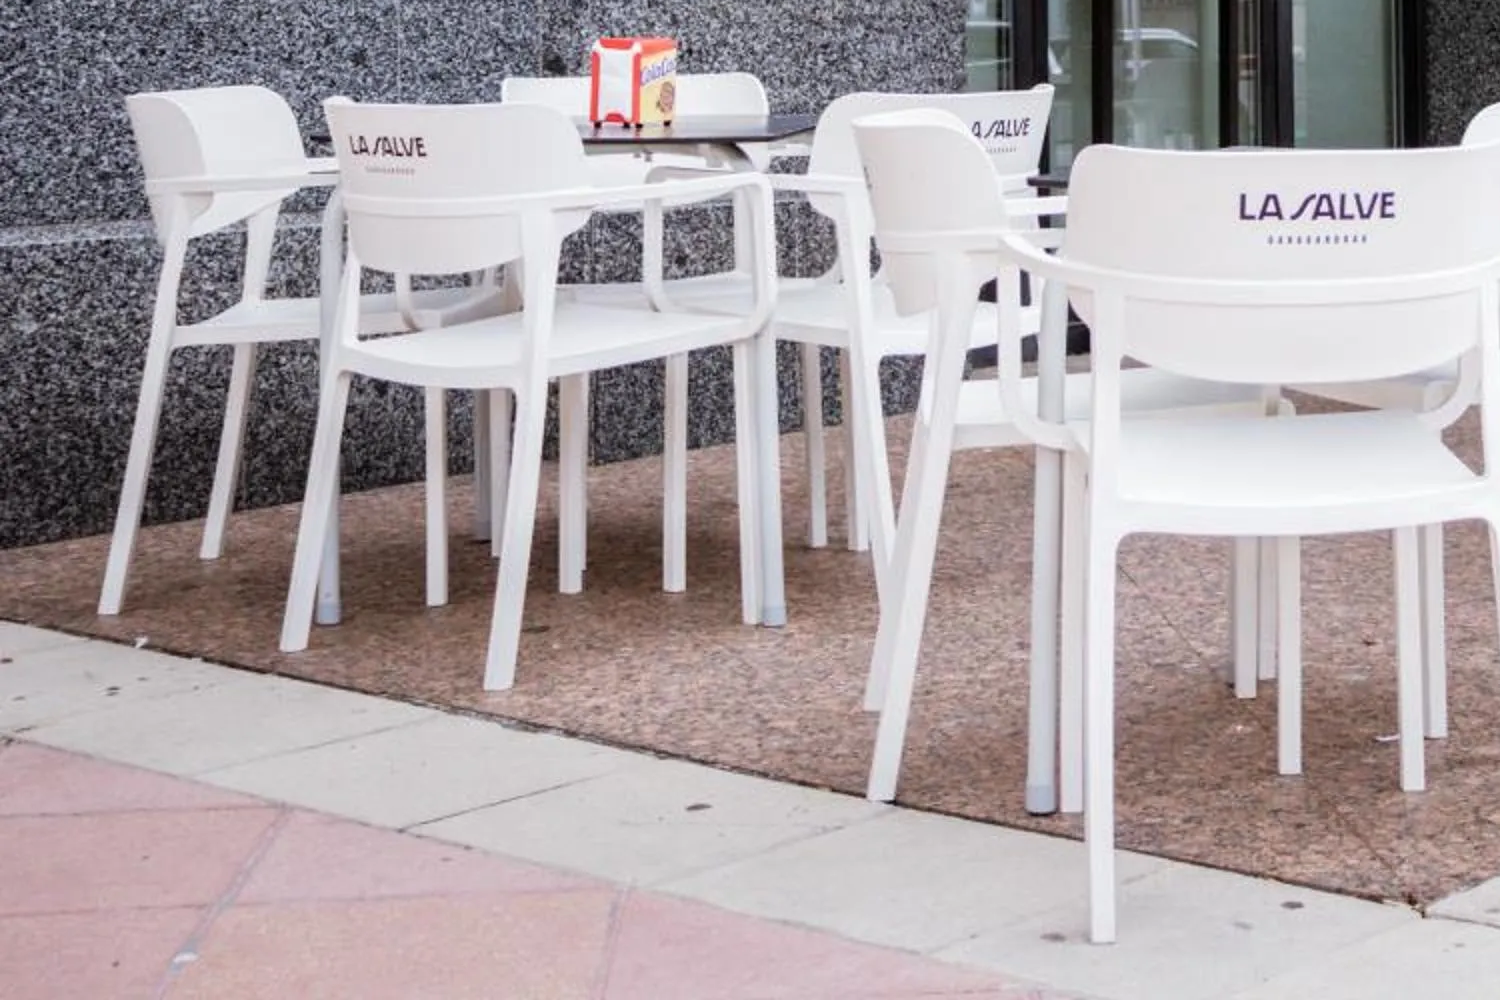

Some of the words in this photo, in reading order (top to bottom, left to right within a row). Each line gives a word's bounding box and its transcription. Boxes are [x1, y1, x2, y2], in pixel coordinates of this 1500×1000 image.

[983, 117, 1031, 139] SALVE
[348, 135, 370, 156] LA
[372, 136, 427, 157] SALVE
[1239, 193, 1284, 220] LA
[1290, 191, 1395, 220] SALVE
